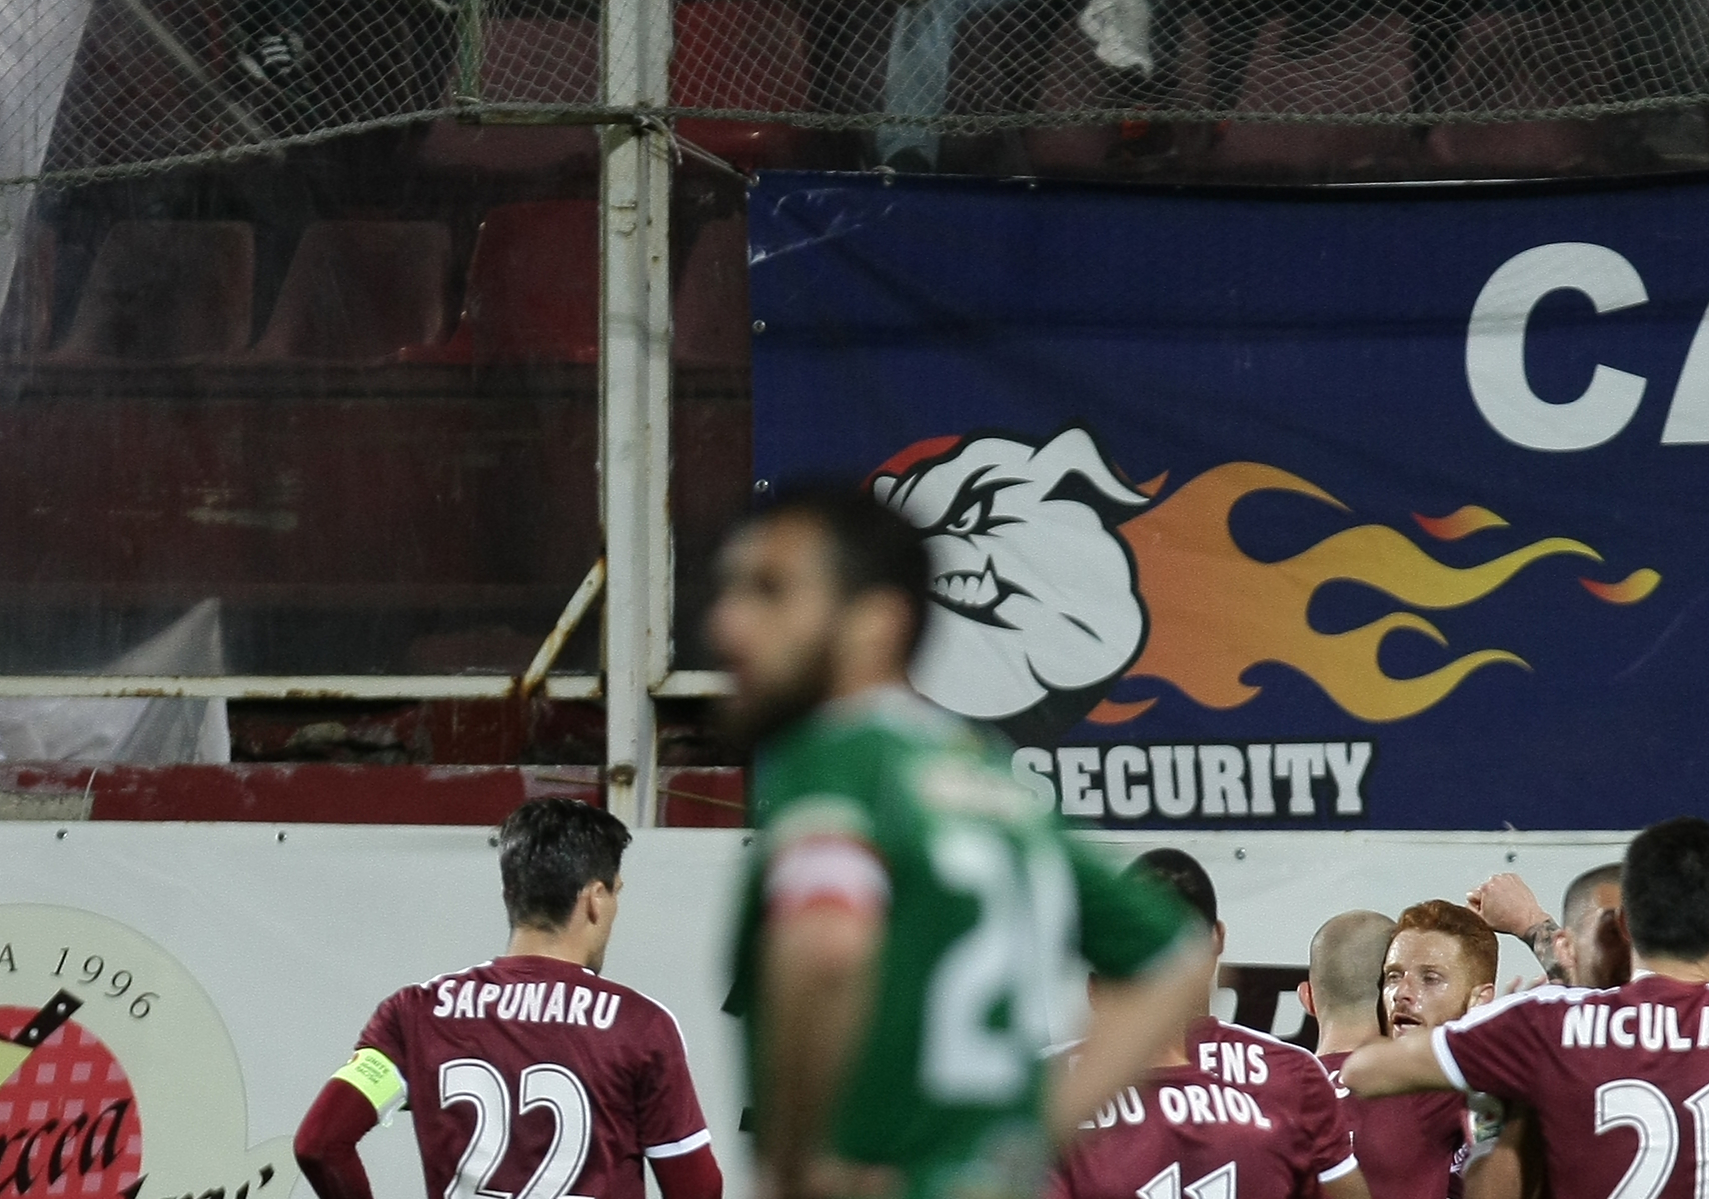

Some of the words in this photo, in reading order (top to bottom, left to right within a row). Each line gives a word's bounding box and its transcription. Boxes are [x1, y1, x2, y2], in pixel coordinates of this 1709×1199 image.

[1010, 740, 1374, 818] SECURITY
[50, 946, 160, 1020] 1996
[433, 978, 622, 1030] SAPUNARU
[1078, 1086, 1146, 1130] DU
[1158, 1084, 1272, 1130] ORIOL
